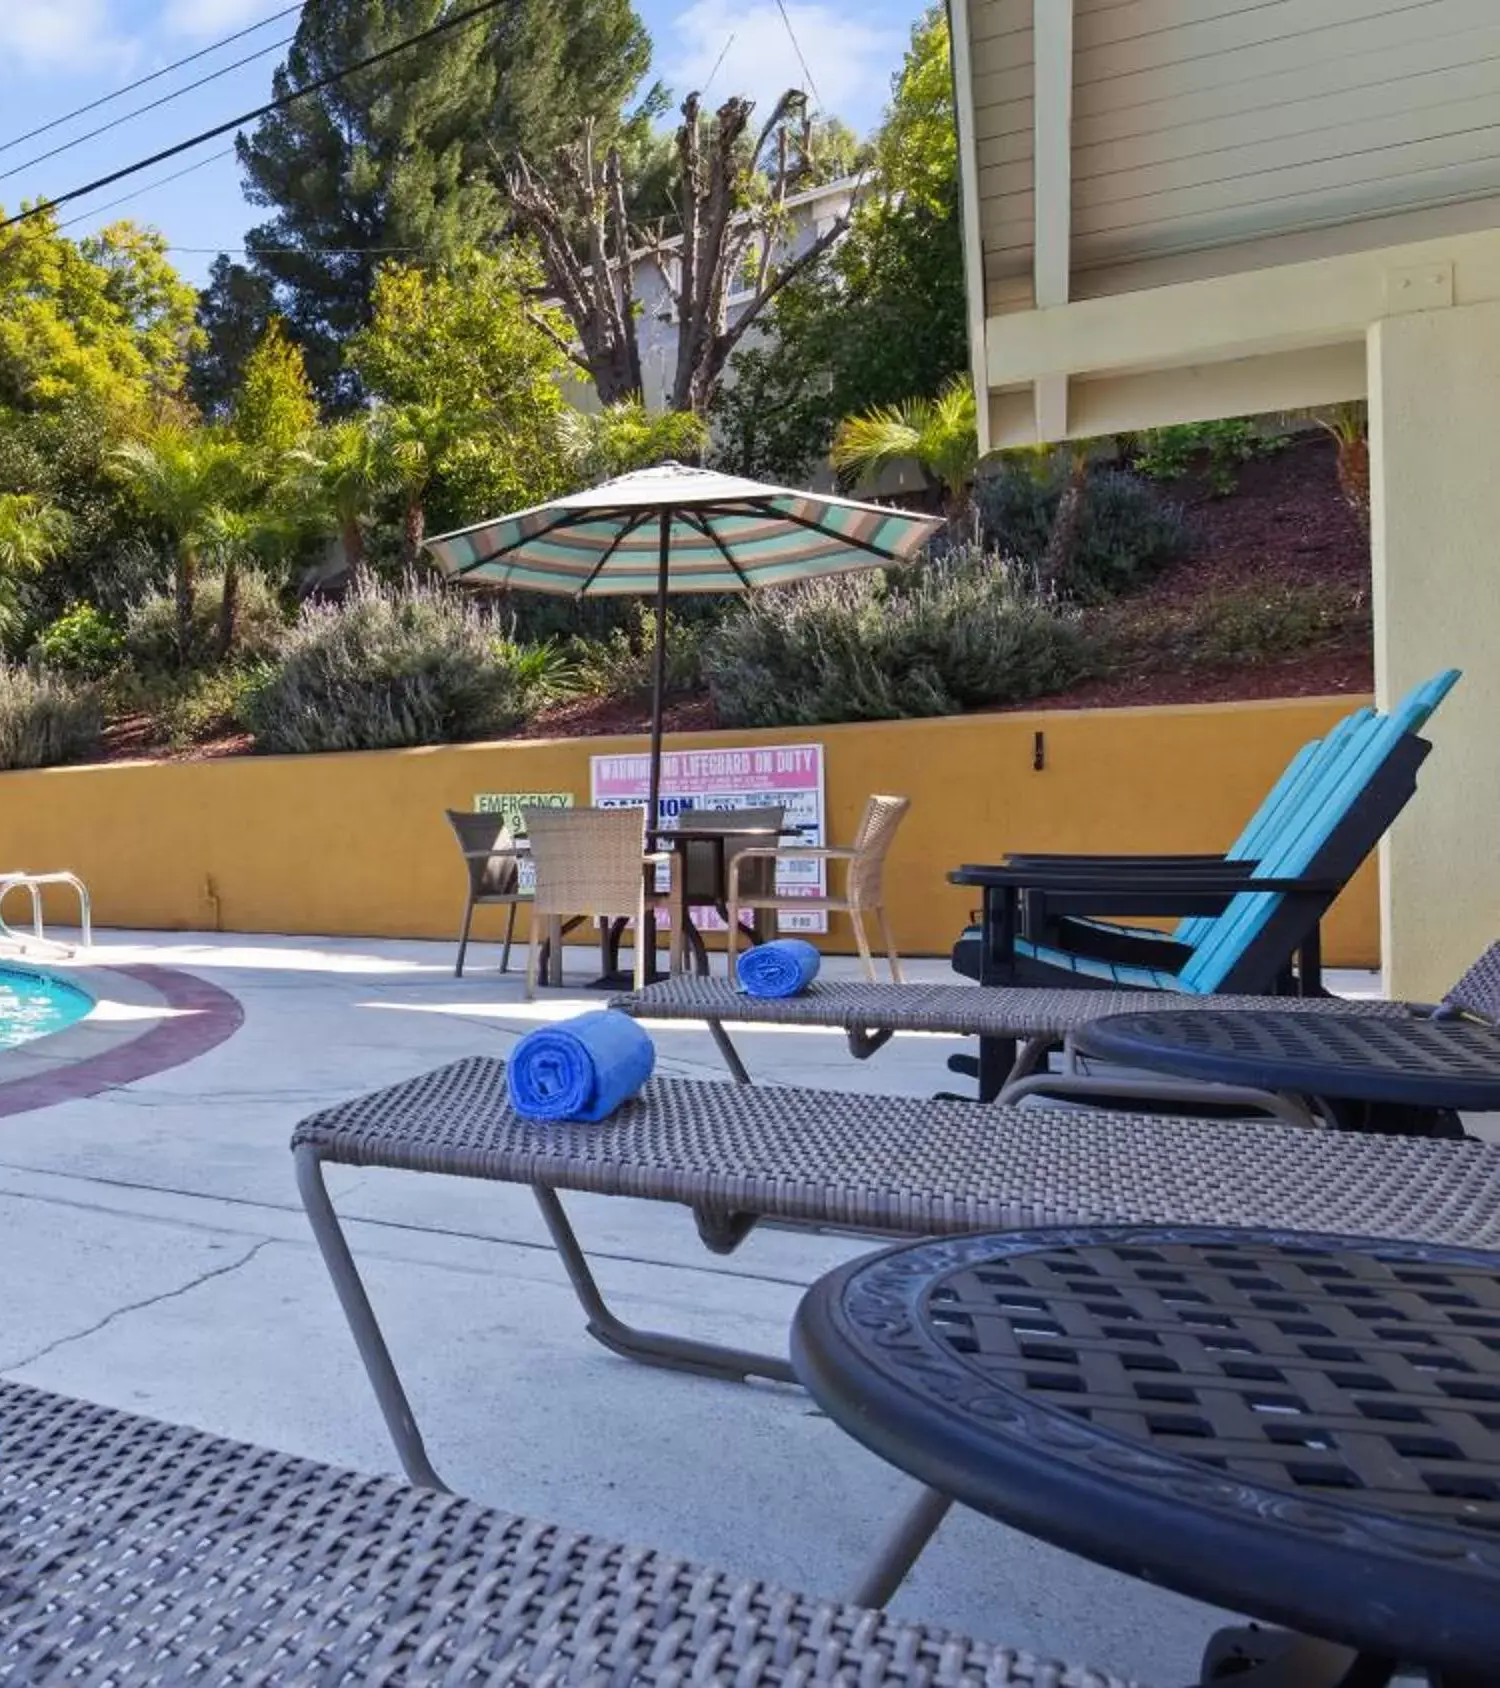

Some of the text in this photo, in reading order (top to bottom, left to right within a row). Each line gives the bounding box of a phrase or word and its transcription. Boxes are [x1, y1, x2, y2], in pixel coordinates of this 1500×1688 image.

[600, 760, 651, 781] WARNIN
[755, 752, 773, 773] ON
[778, 750, 813, 773] DUTY
[479, 795, 568, 813] EMERGENCY
